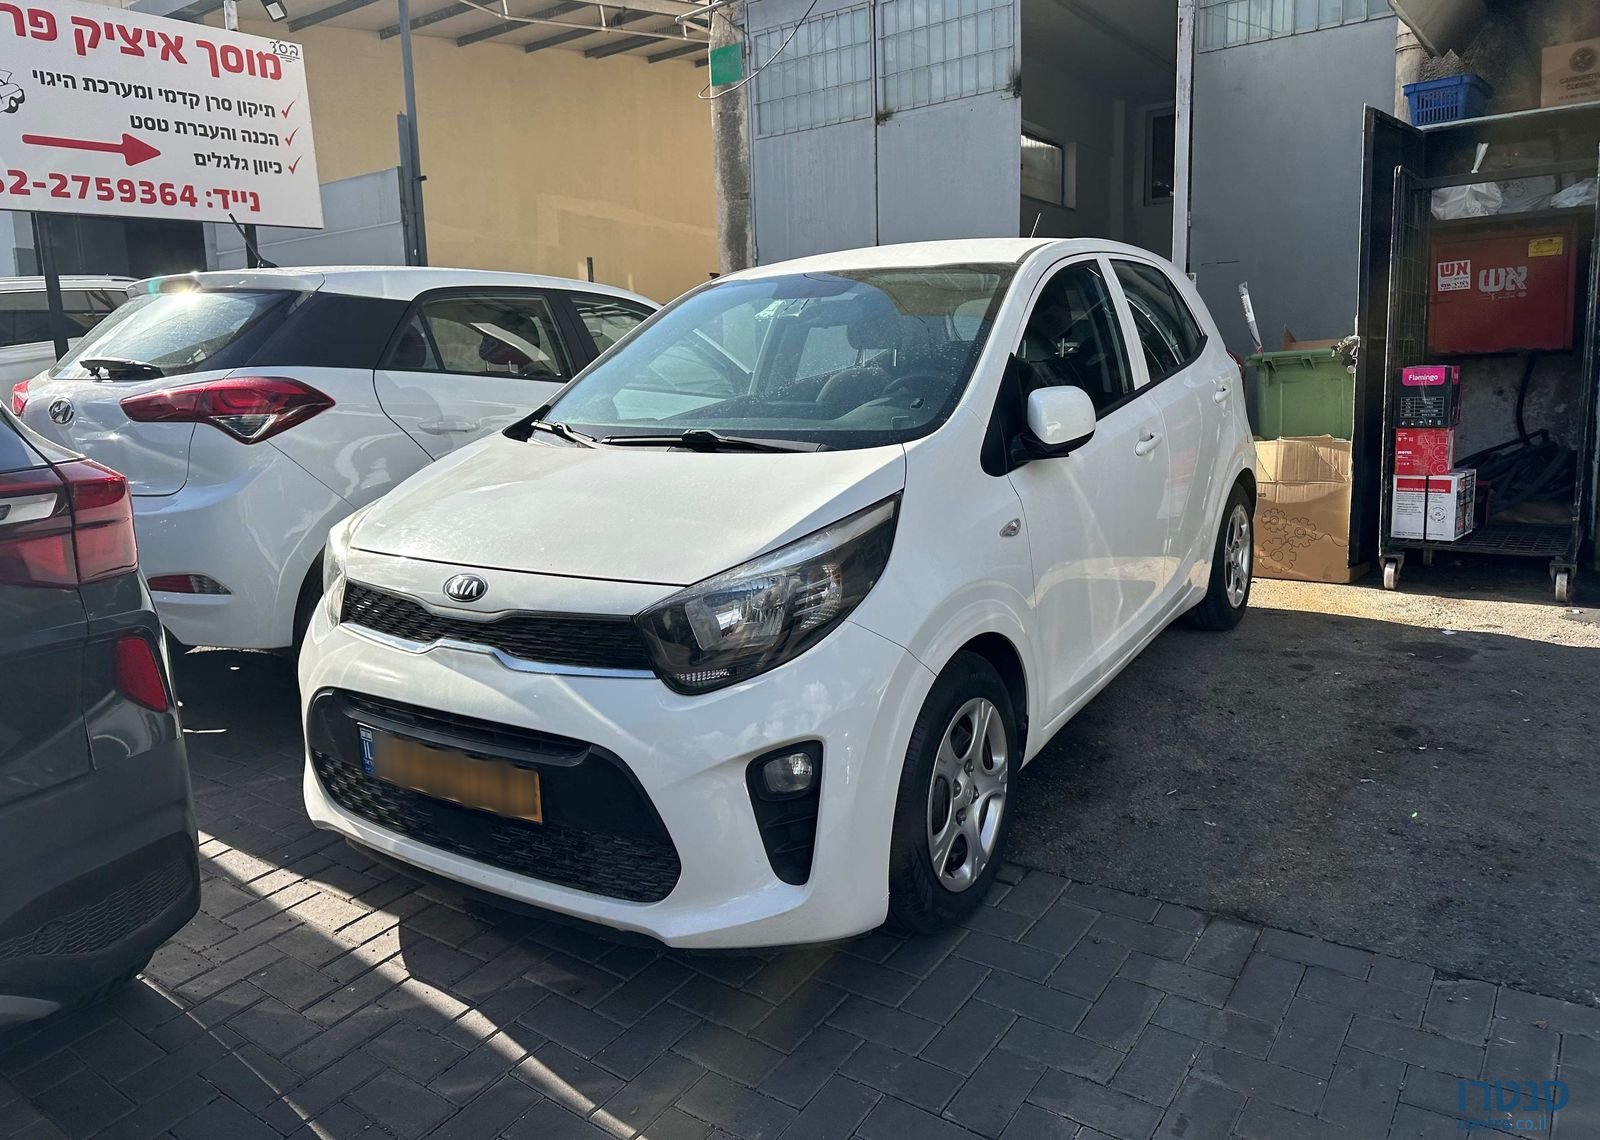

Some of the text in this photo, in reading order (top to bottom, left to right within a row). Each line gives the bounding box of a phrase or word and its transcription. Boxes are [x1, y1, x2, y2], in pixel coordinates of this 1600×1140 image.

[71, 15, 187, 64] איציק
[196, 40, 282, 80] מוסך
[32, 69, 276, 118] תיקון סרן קדמי ומערכת היגוי
[129, 114, 279, 146] הכנה והעברת טסט
[193, 152, 282, 175] כיוון גלגלים
[0, 169, 261, 212] נייד: 2-2759364
[1440, 262, 1468, 278] אש
[1479, 266, 1527, 293] אש
[1408, 374, 1439, 382] Flamingo
[449, 578, 478, 597] KIA
